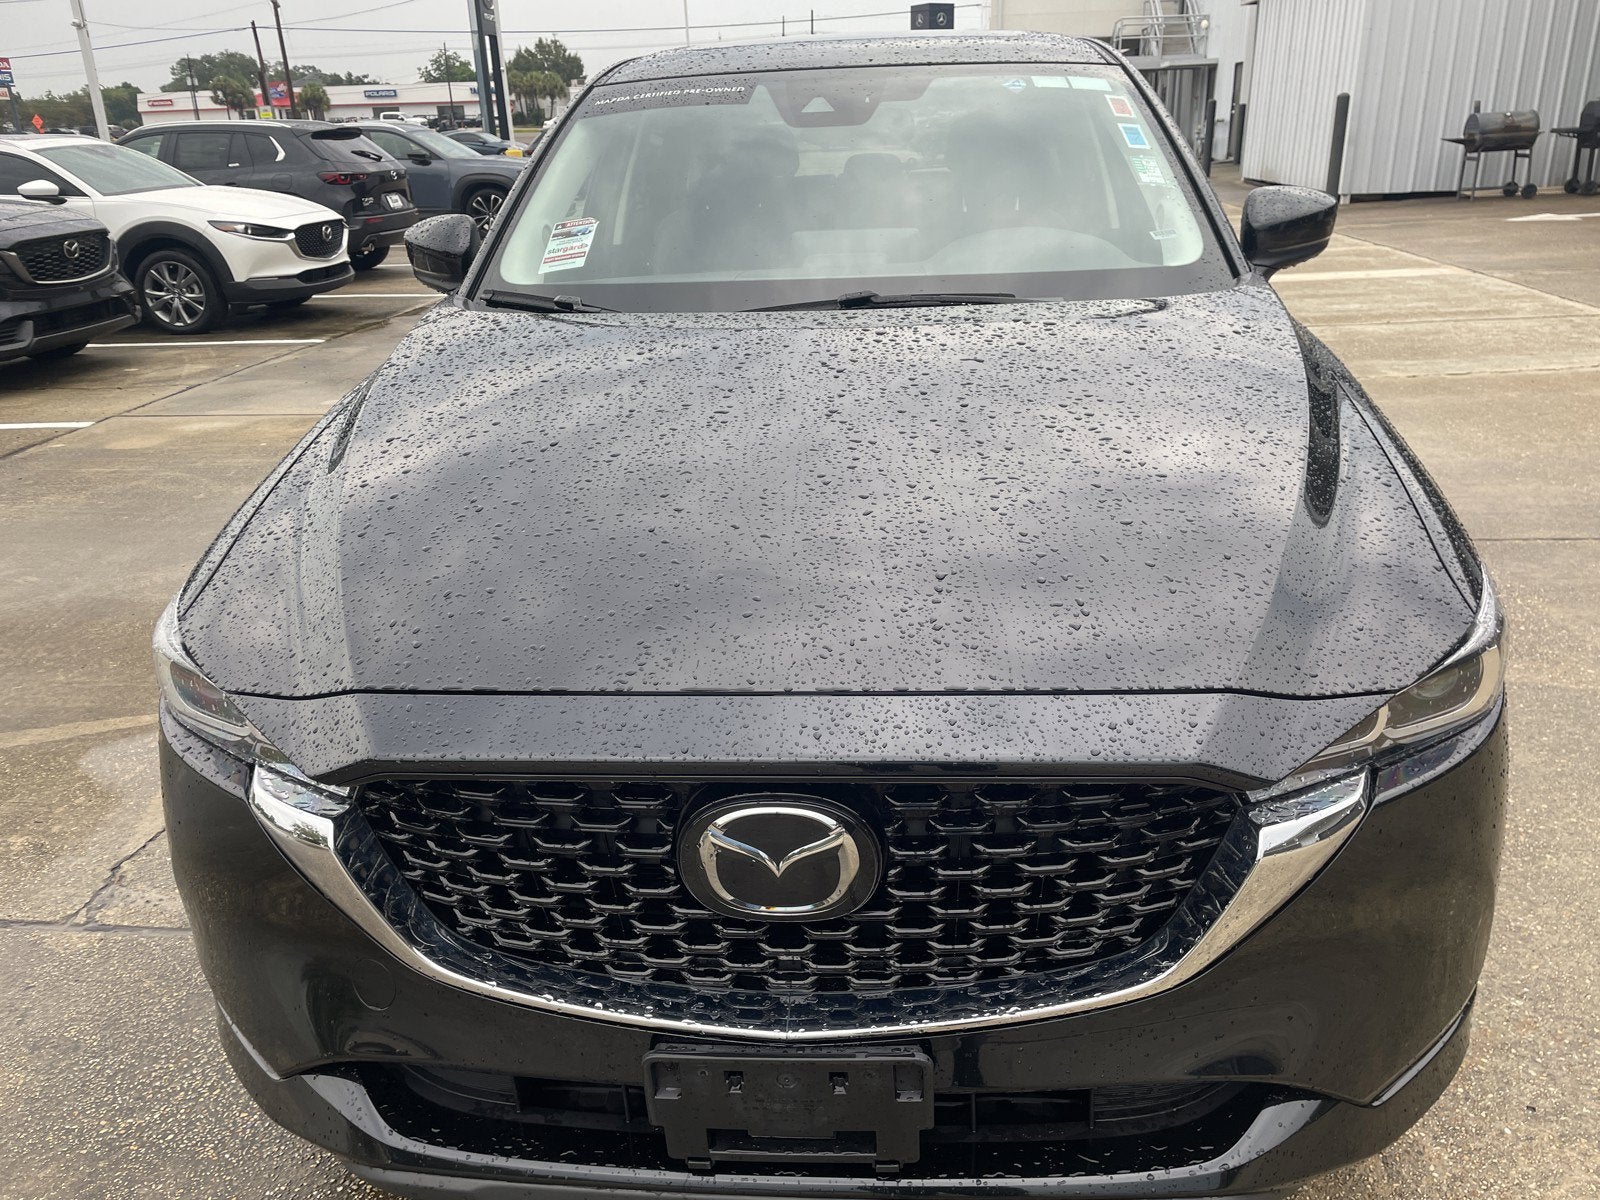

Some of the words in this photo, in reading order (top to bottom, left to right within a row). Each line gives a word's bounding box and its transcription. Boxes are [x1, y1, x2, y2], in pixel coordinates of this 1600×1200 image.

[594, 96, 631, 106] MAZDA
[633, 90, 681, 99] CERTIFIED
[683, 86, 745, 94] PRE-OWNED
